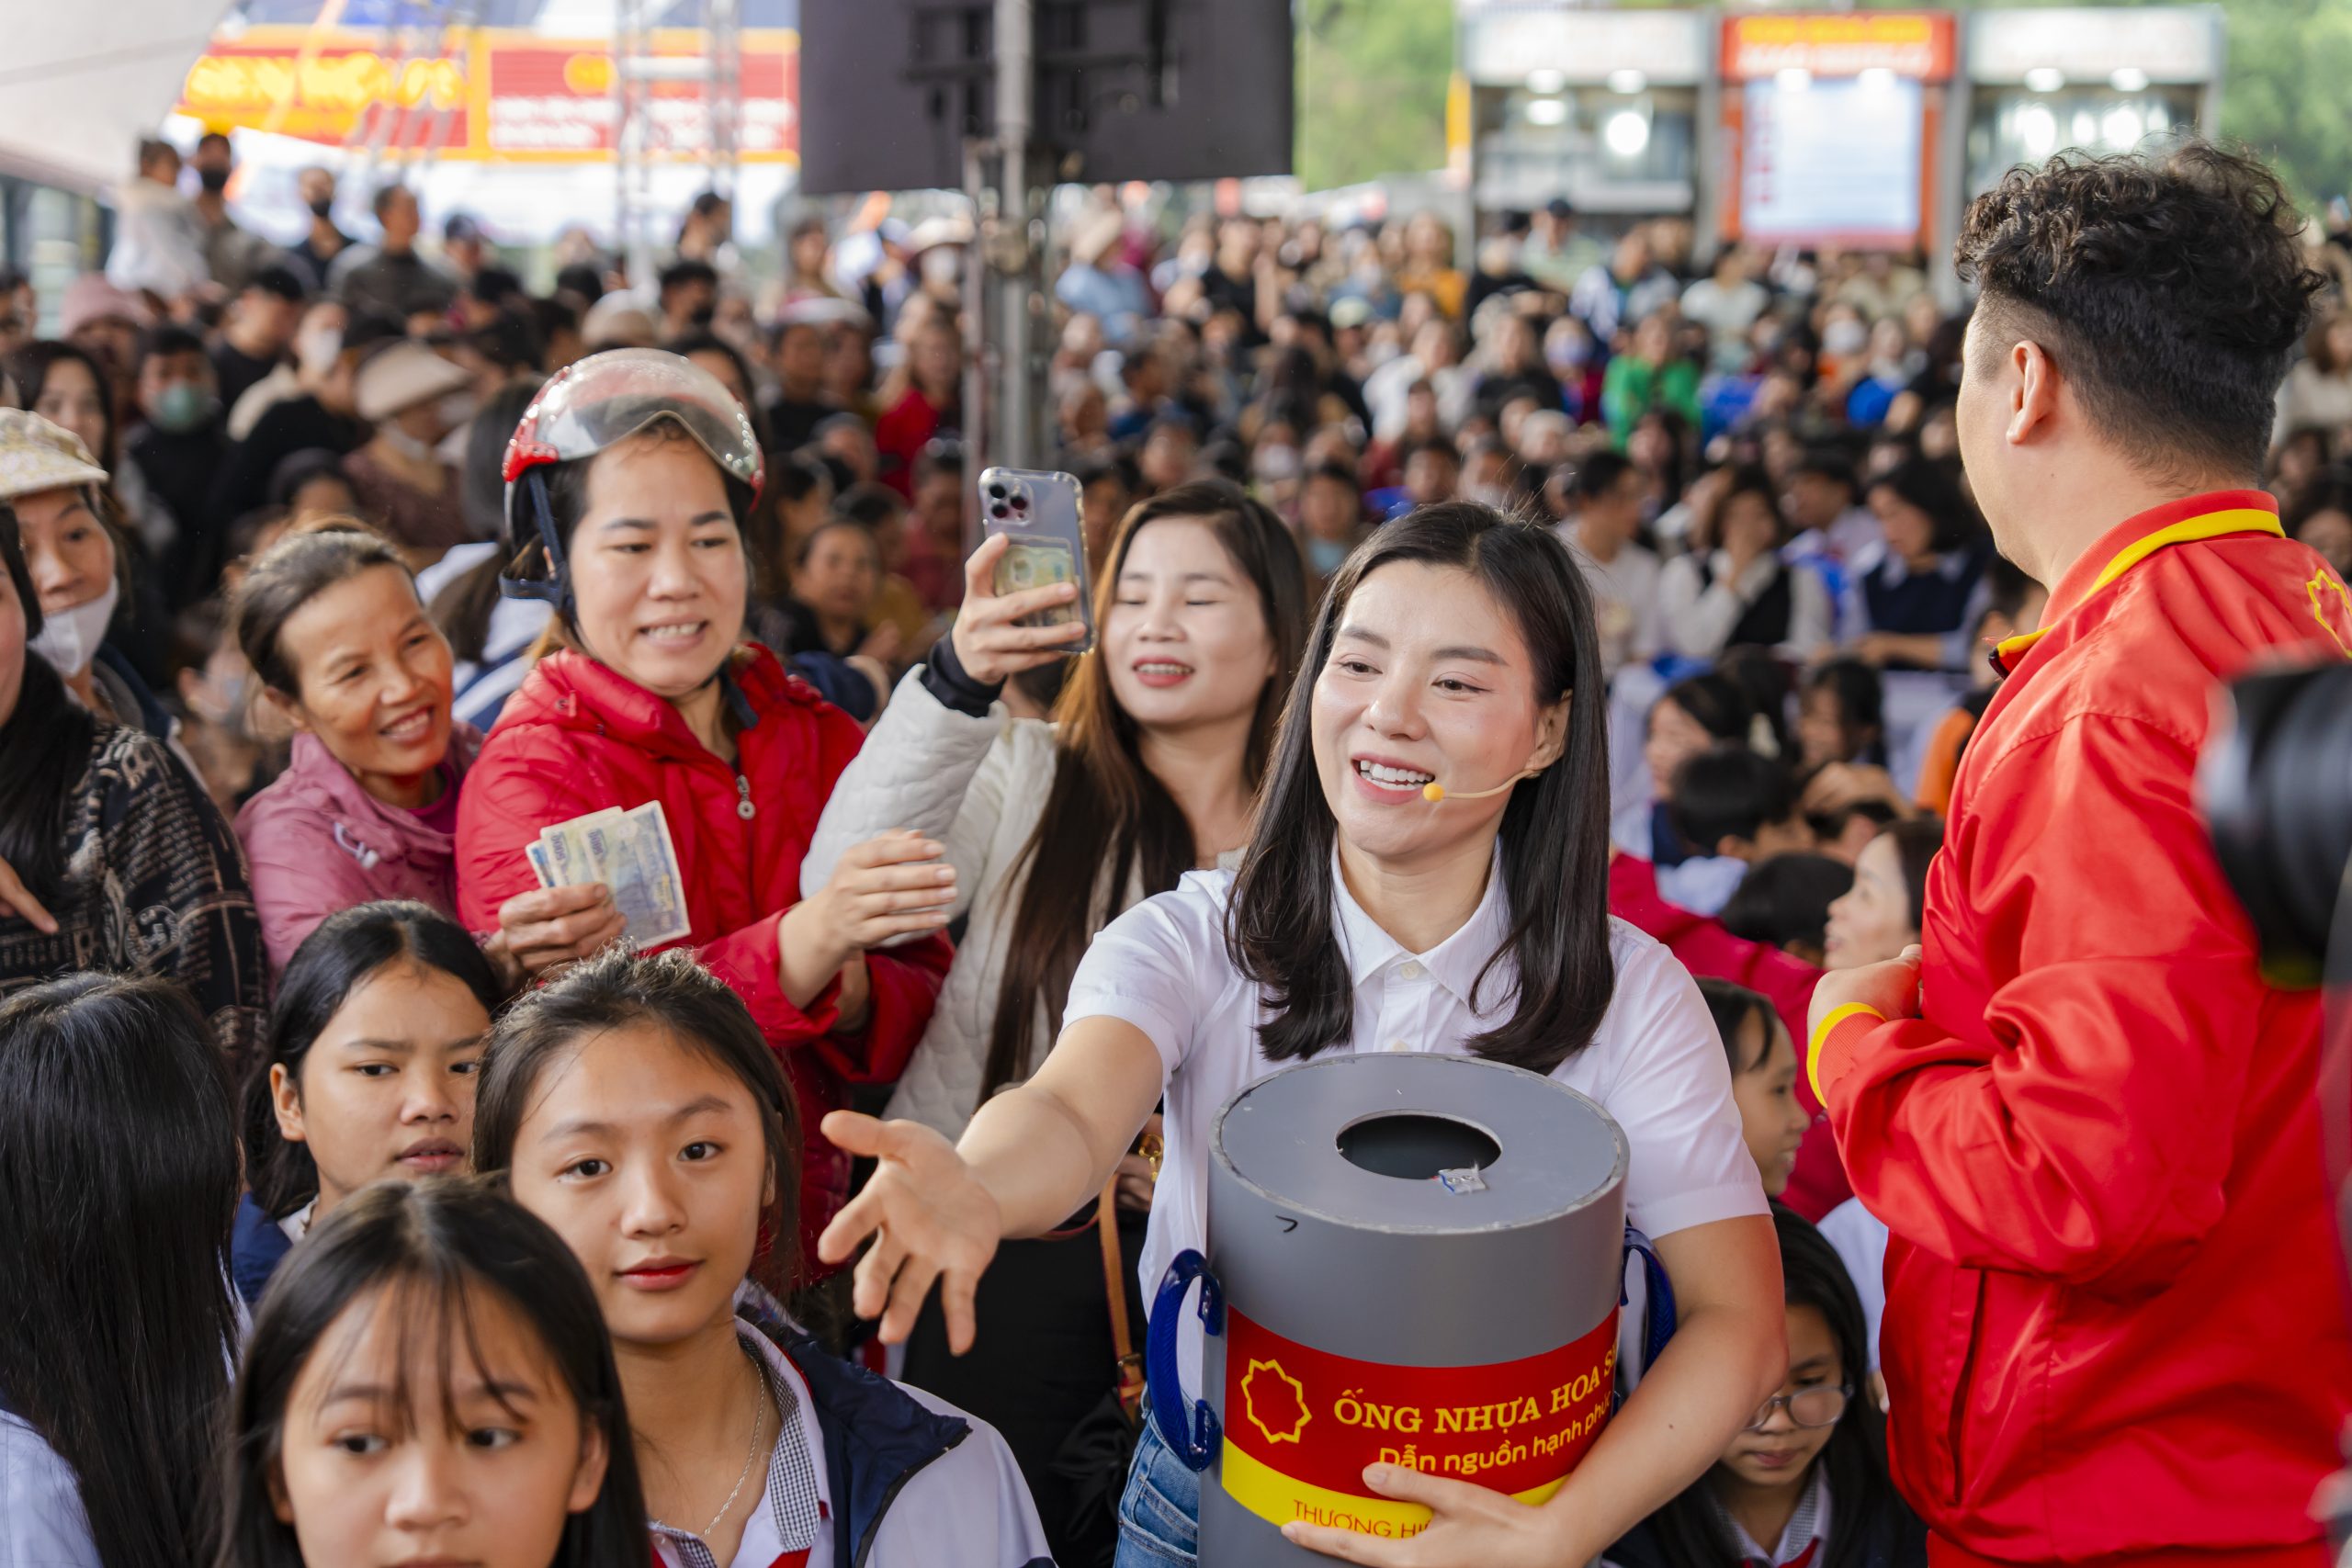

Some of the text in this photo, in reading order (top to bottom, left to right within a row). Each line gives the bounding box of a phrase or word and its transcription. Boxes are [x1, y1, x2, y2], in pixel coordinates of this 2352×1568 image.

[1334, 1388, 1423, 1433] ỐNG
[1433, 1396, 1542, 1434] NHỰA
[1549, 1366, 1600, 1414] HOA
[1380, 1443, 1436, 1472] Dẫn
[1444, 1439, 1527, 1475] nguồn
[1532, 1420, 1582, 1458] hạnh
[1293, 1499, 1392, 1538] THƯƠNG
